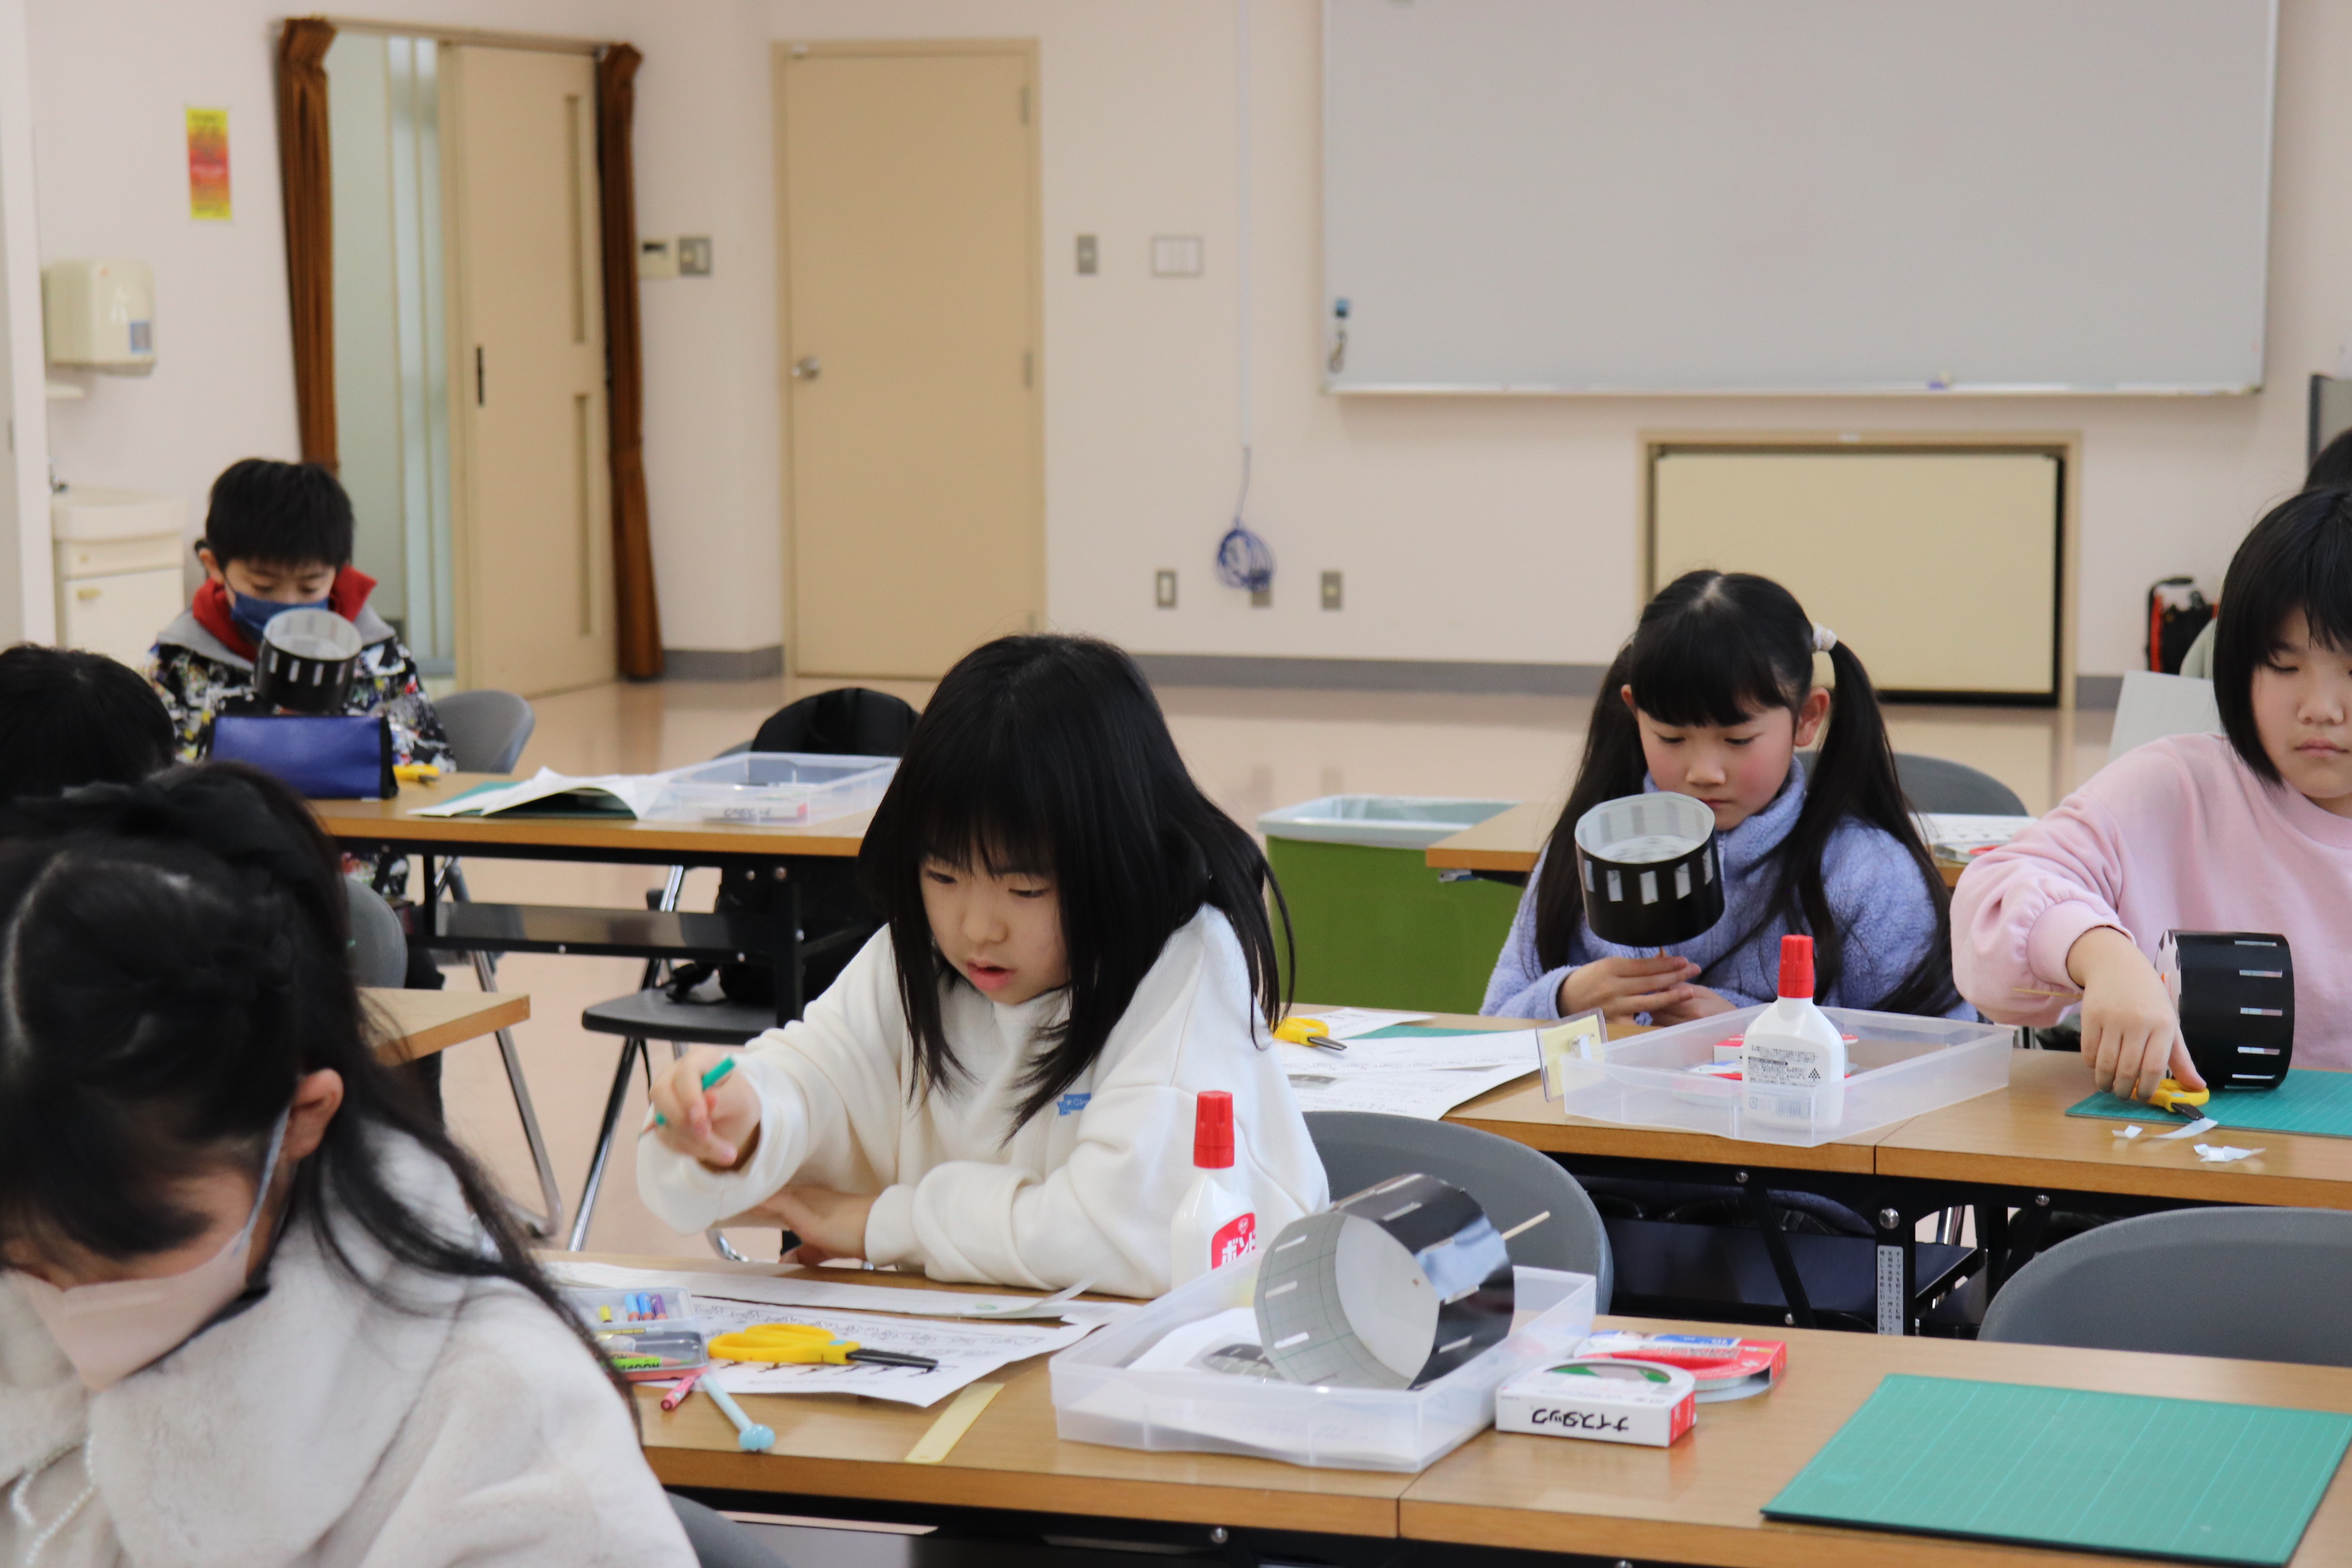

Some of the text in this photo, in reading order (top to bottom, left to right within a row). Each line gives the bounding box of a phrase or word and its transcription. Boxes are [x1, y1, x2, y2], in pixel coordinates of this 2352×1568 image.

[1531, 1408, 1629, 1432] ナイスタック
